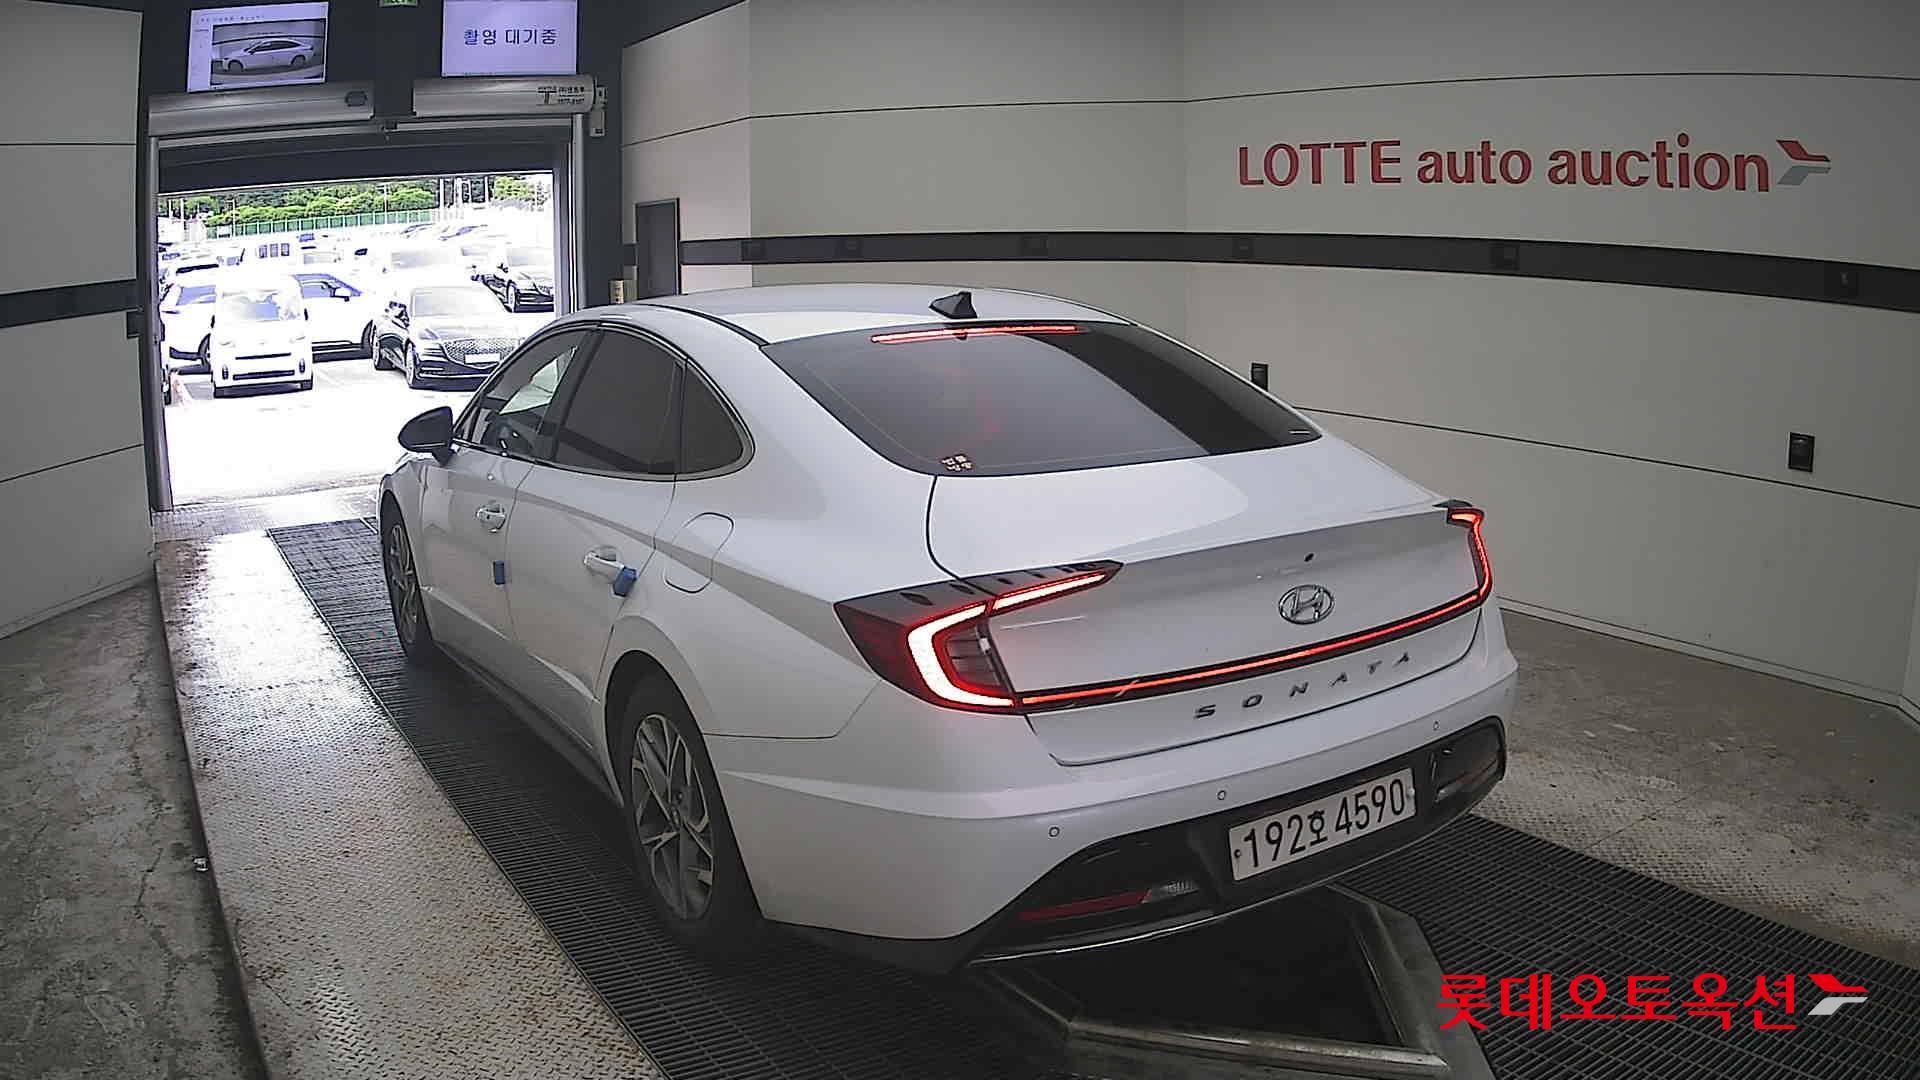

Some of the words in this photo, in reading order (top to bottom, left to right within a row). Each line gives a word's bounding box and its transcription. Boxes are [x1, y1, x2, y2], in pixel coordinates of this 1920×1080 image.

[463, 29, 497, 46] 촬영
[505, 29, 558, 45] 대기중
[1238, 139, 1401, 187] LOTTE
[1416, 140, 1533, 186] auto
[1547, 132, 1770, 193] auction
[1193, 652, 1411, 720] SONATA
[1243, 808, 1329, 868] 192호
[1334, 777, 1406, 836] 4590
